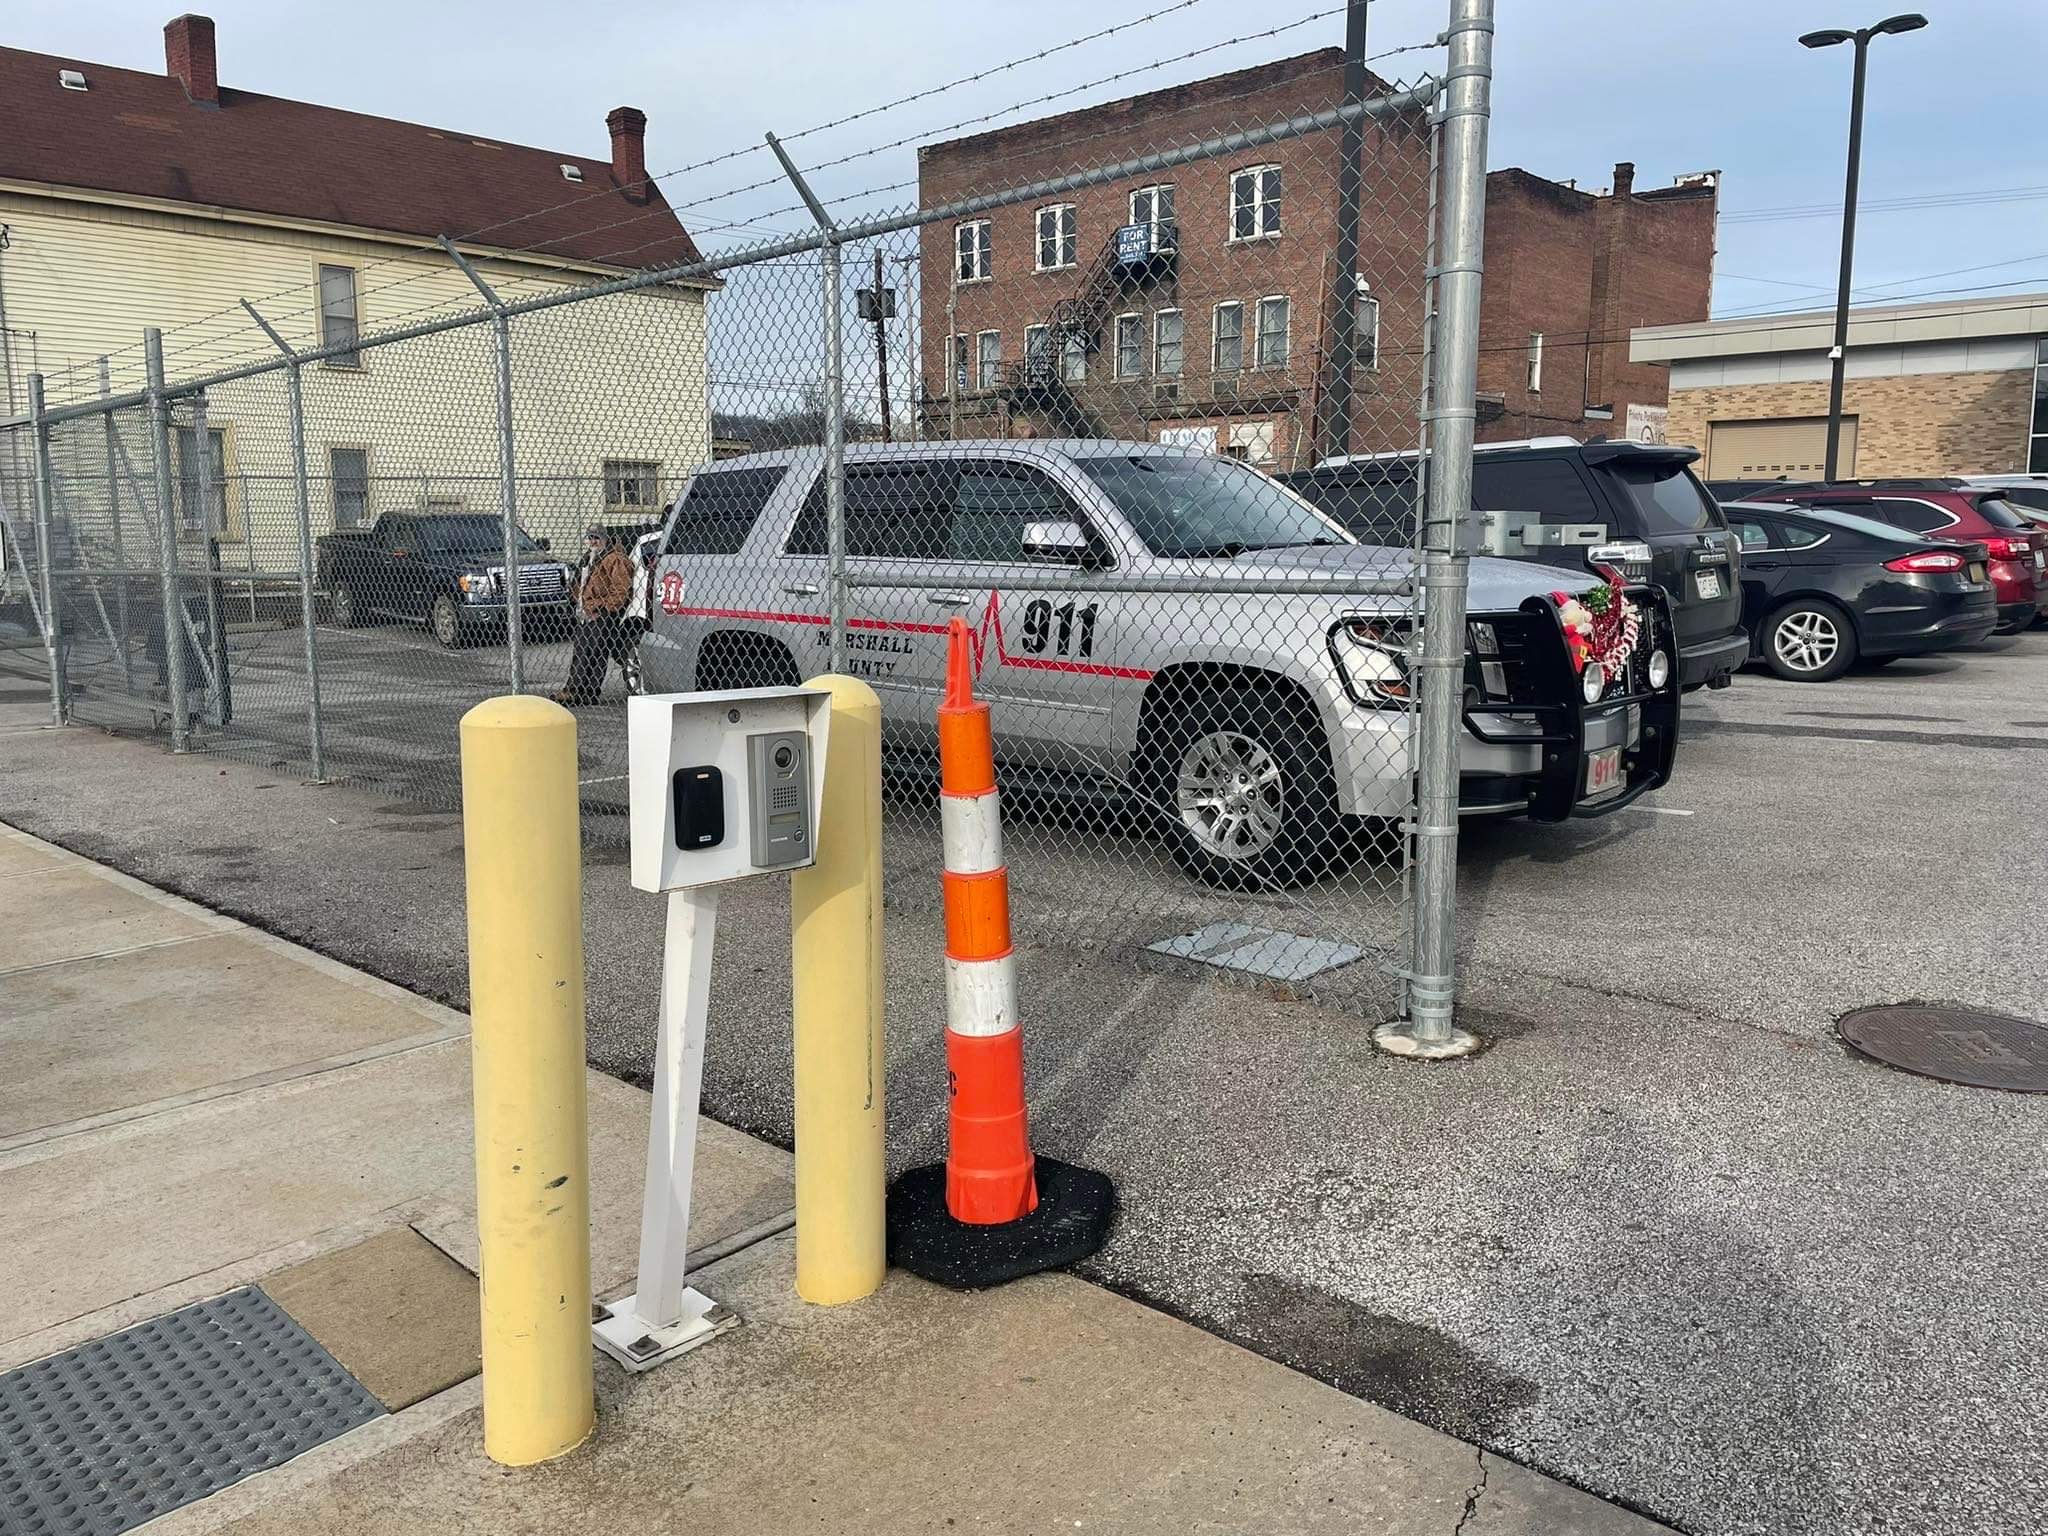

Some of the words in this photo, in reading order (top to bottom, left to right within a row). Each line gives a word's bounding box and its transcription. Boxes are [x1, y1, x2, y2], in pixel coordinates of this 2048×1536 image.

[1120, 240, 1147, 253] RENT
[1123, 230, 1144, 242] FOR
[656, 582, 685, 603] 911
[1022, 600, 1099, 657] 911
[817, 631, 913, 654] MRSHALL
[826, 658, 896, 677] UNTY
[1594, 757, 1616, 785] 911
